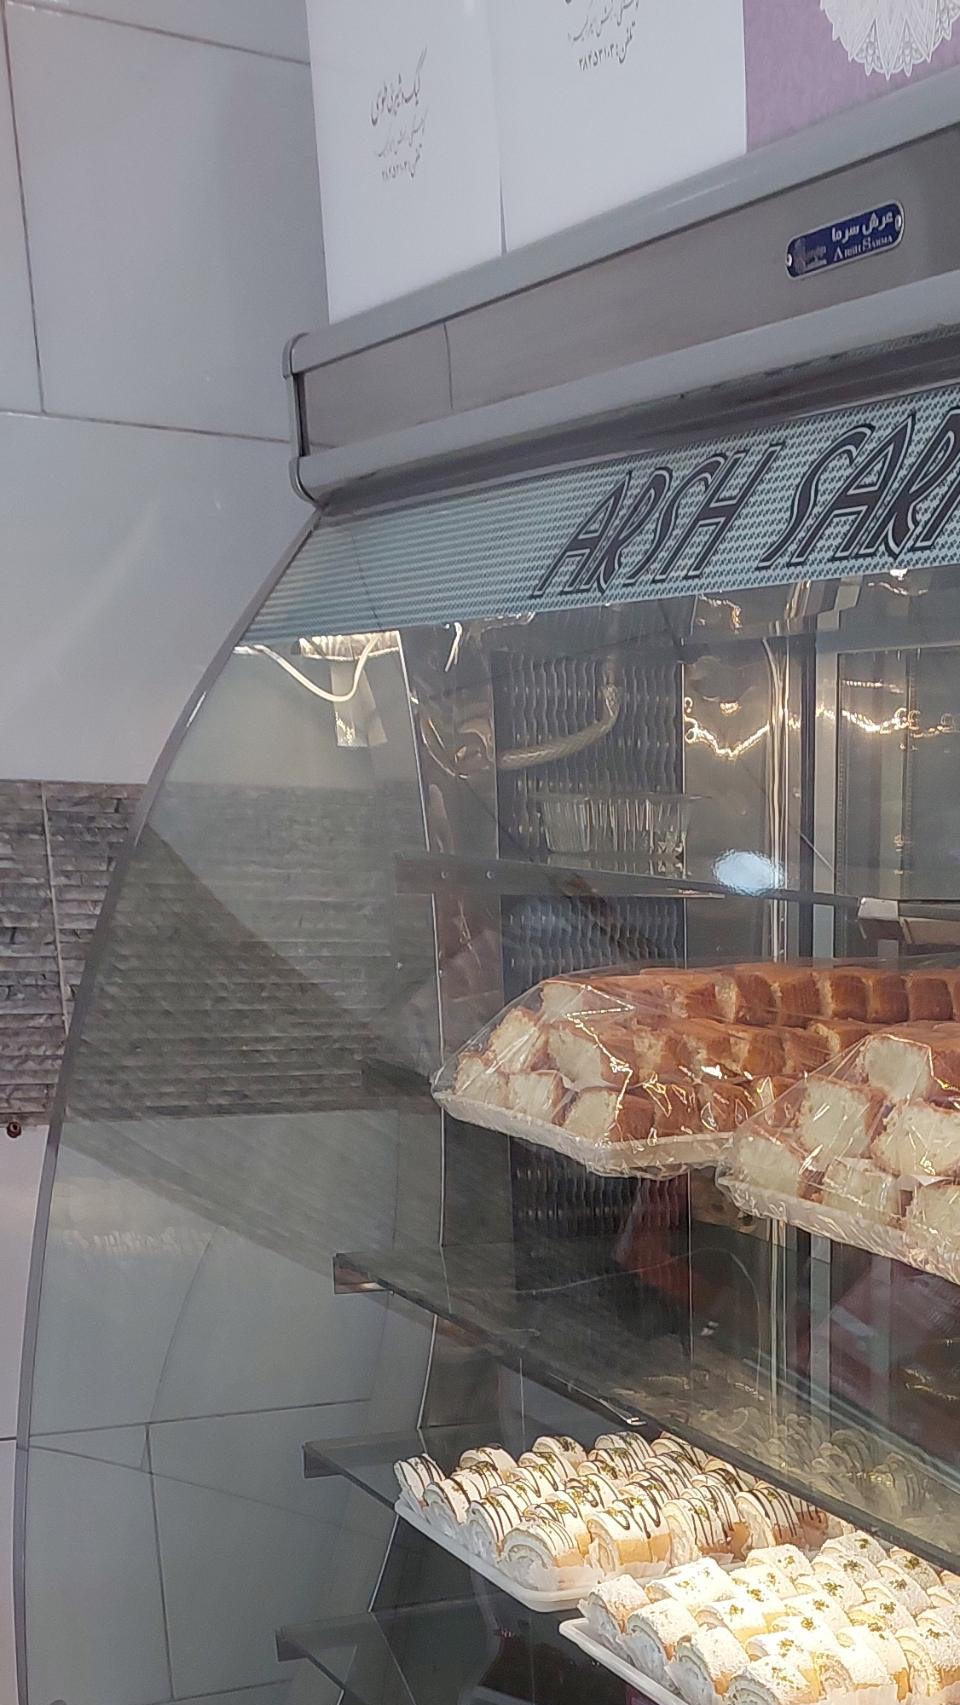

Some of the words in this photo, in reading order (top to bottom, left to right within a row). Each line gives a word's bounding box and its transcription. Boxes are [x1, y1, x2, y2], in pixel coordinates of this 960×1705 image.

[831, 225, 859, 243] سرما
[862, 211, 893, 235] عرش
[532, 442, 785, 595] ARSH
